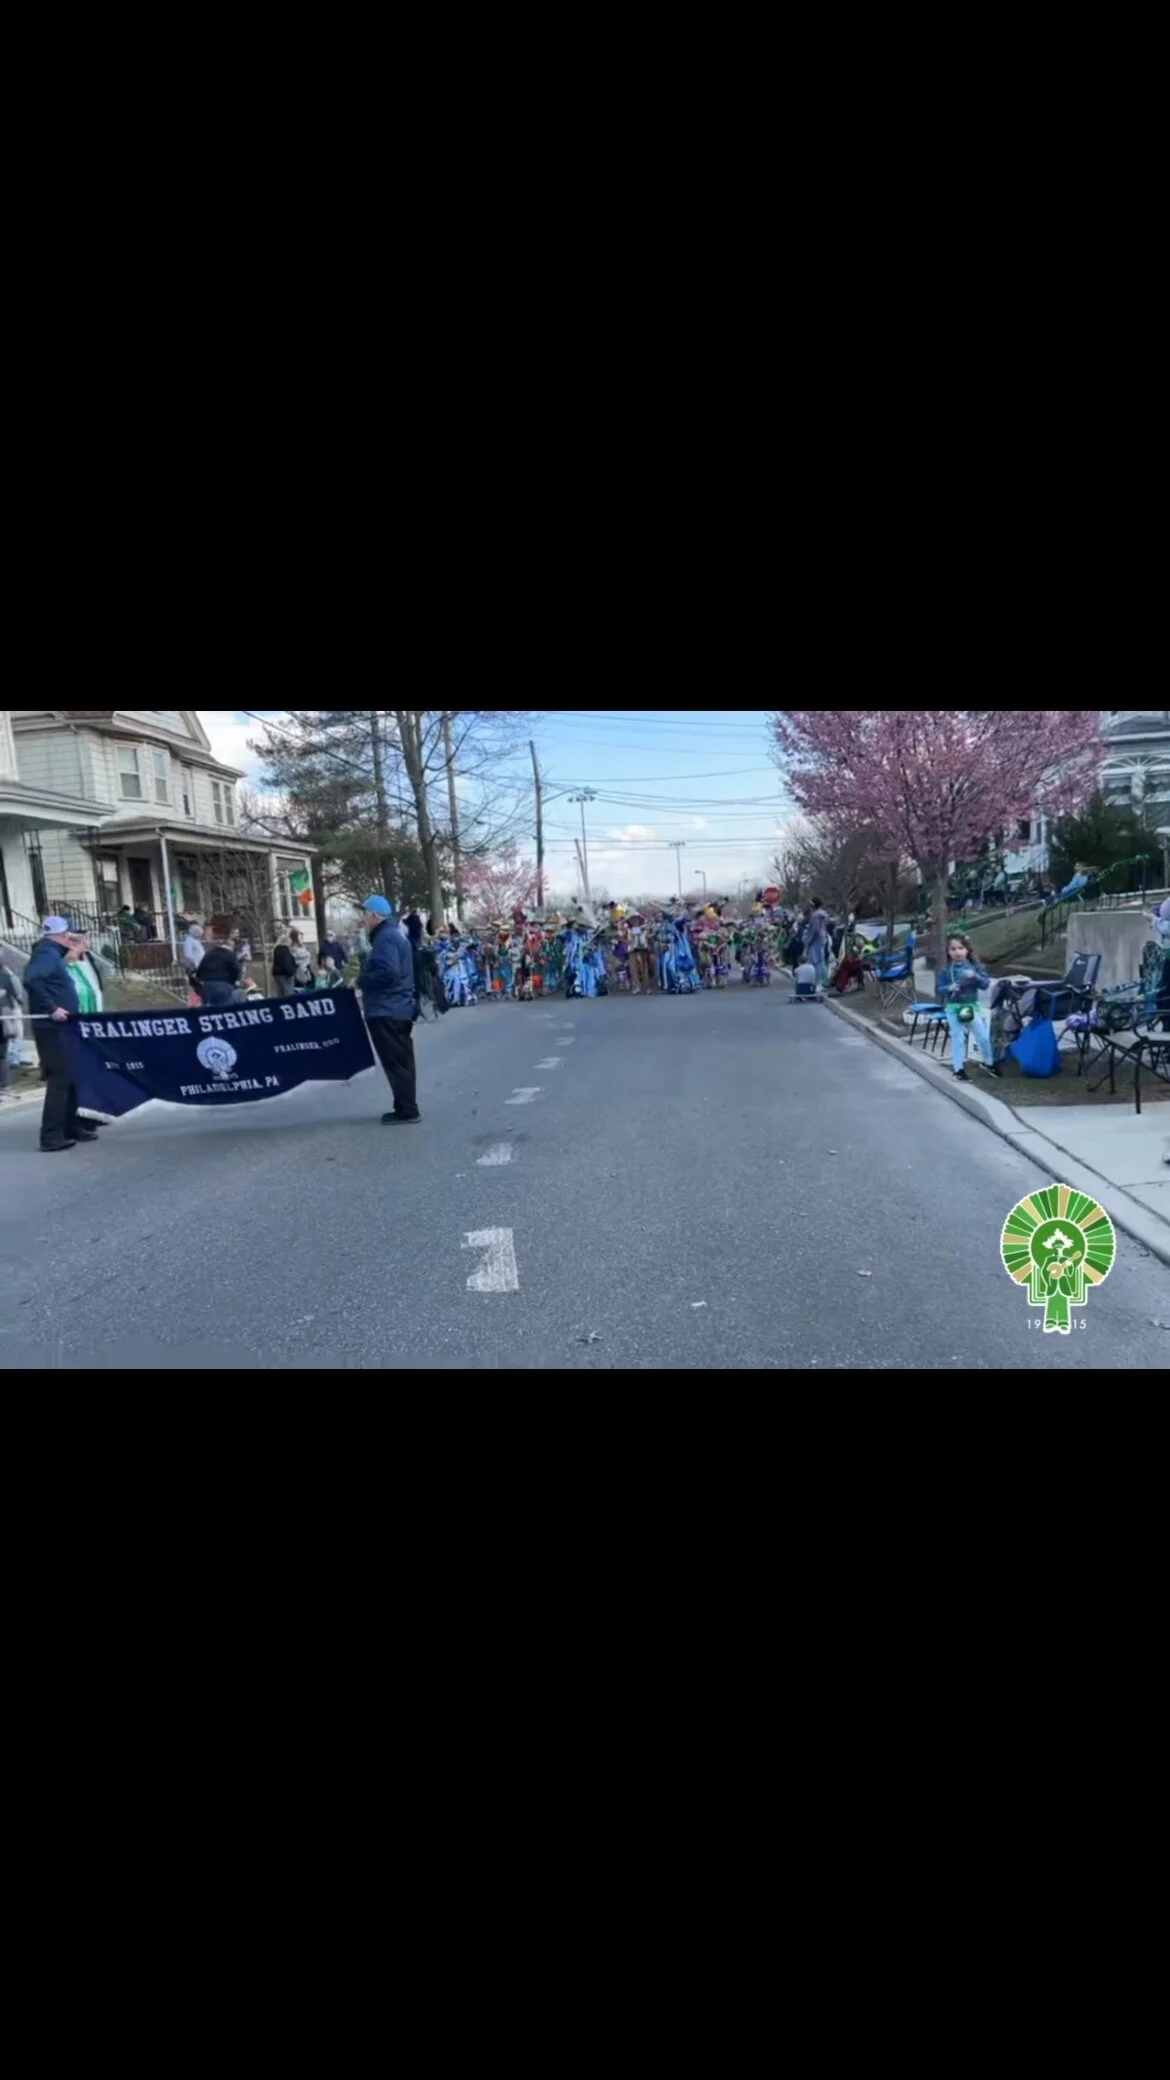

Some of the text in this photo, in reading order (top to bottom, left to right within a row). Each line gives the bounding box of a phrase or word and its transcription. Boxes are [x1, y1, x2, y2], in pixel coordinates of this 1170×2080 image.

[79, 998, 336, 1038] FRALINGER STRING BAND
[265, 1074, 279, 1088] PA
